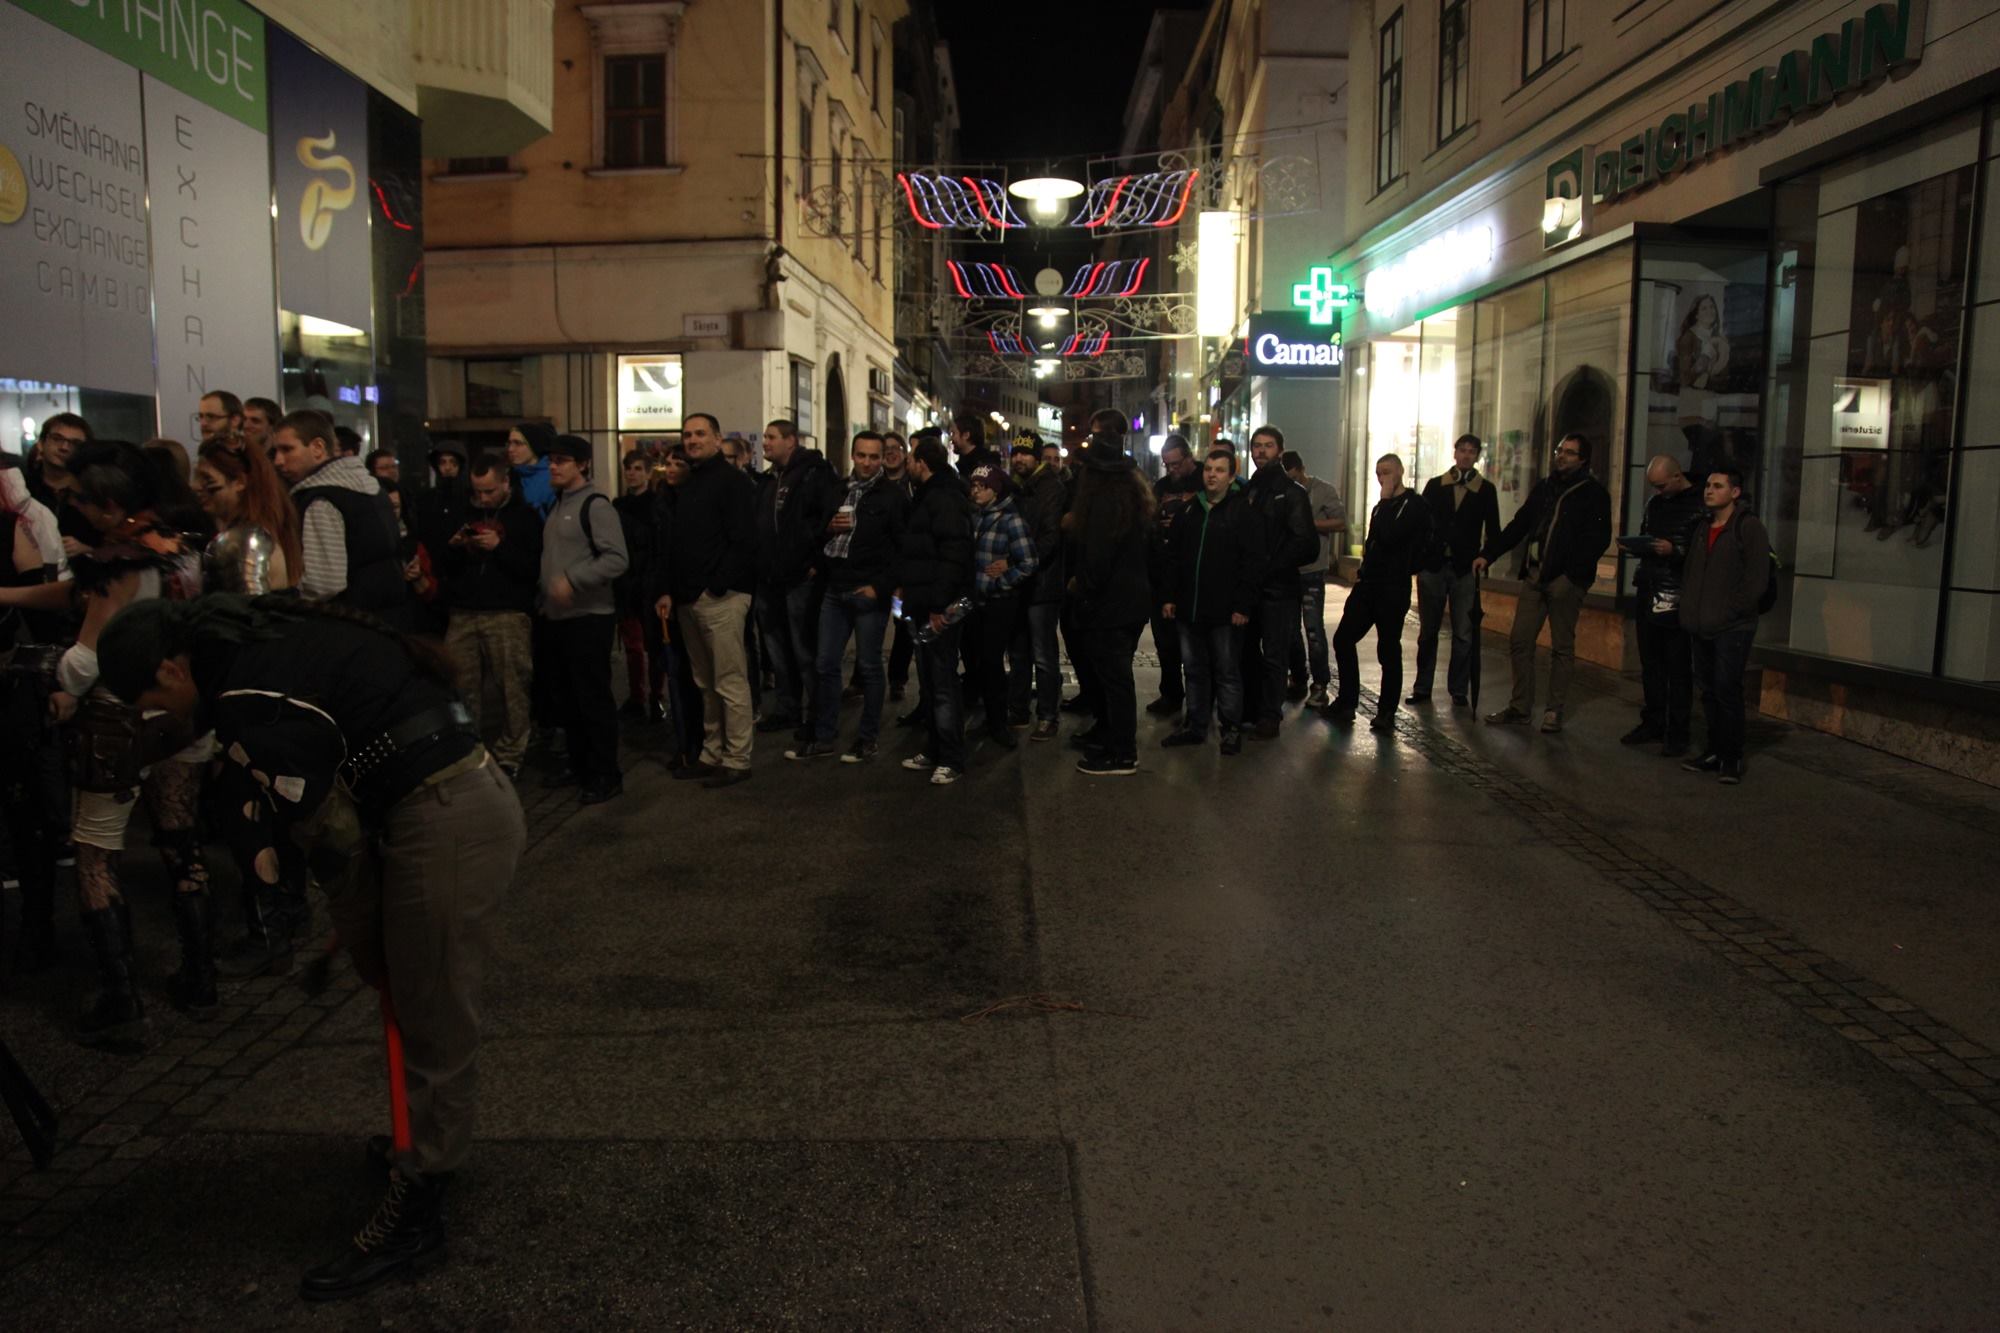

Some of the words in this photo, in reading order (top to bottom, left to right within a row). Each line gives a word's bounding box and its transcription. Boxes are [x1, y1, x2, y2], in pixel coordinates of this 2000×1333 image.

[70, 0, 255, 101] ANGE
[25, 101, 141, 177] SMĚNÁRNA
[1593, 0, 1923, 204] DEICHMANN
[28, 152, 144, 224] WECHSEL
[33, 207, 147, 269] EXCHANGE
[38, 261, 149, 315] CAMBIO
